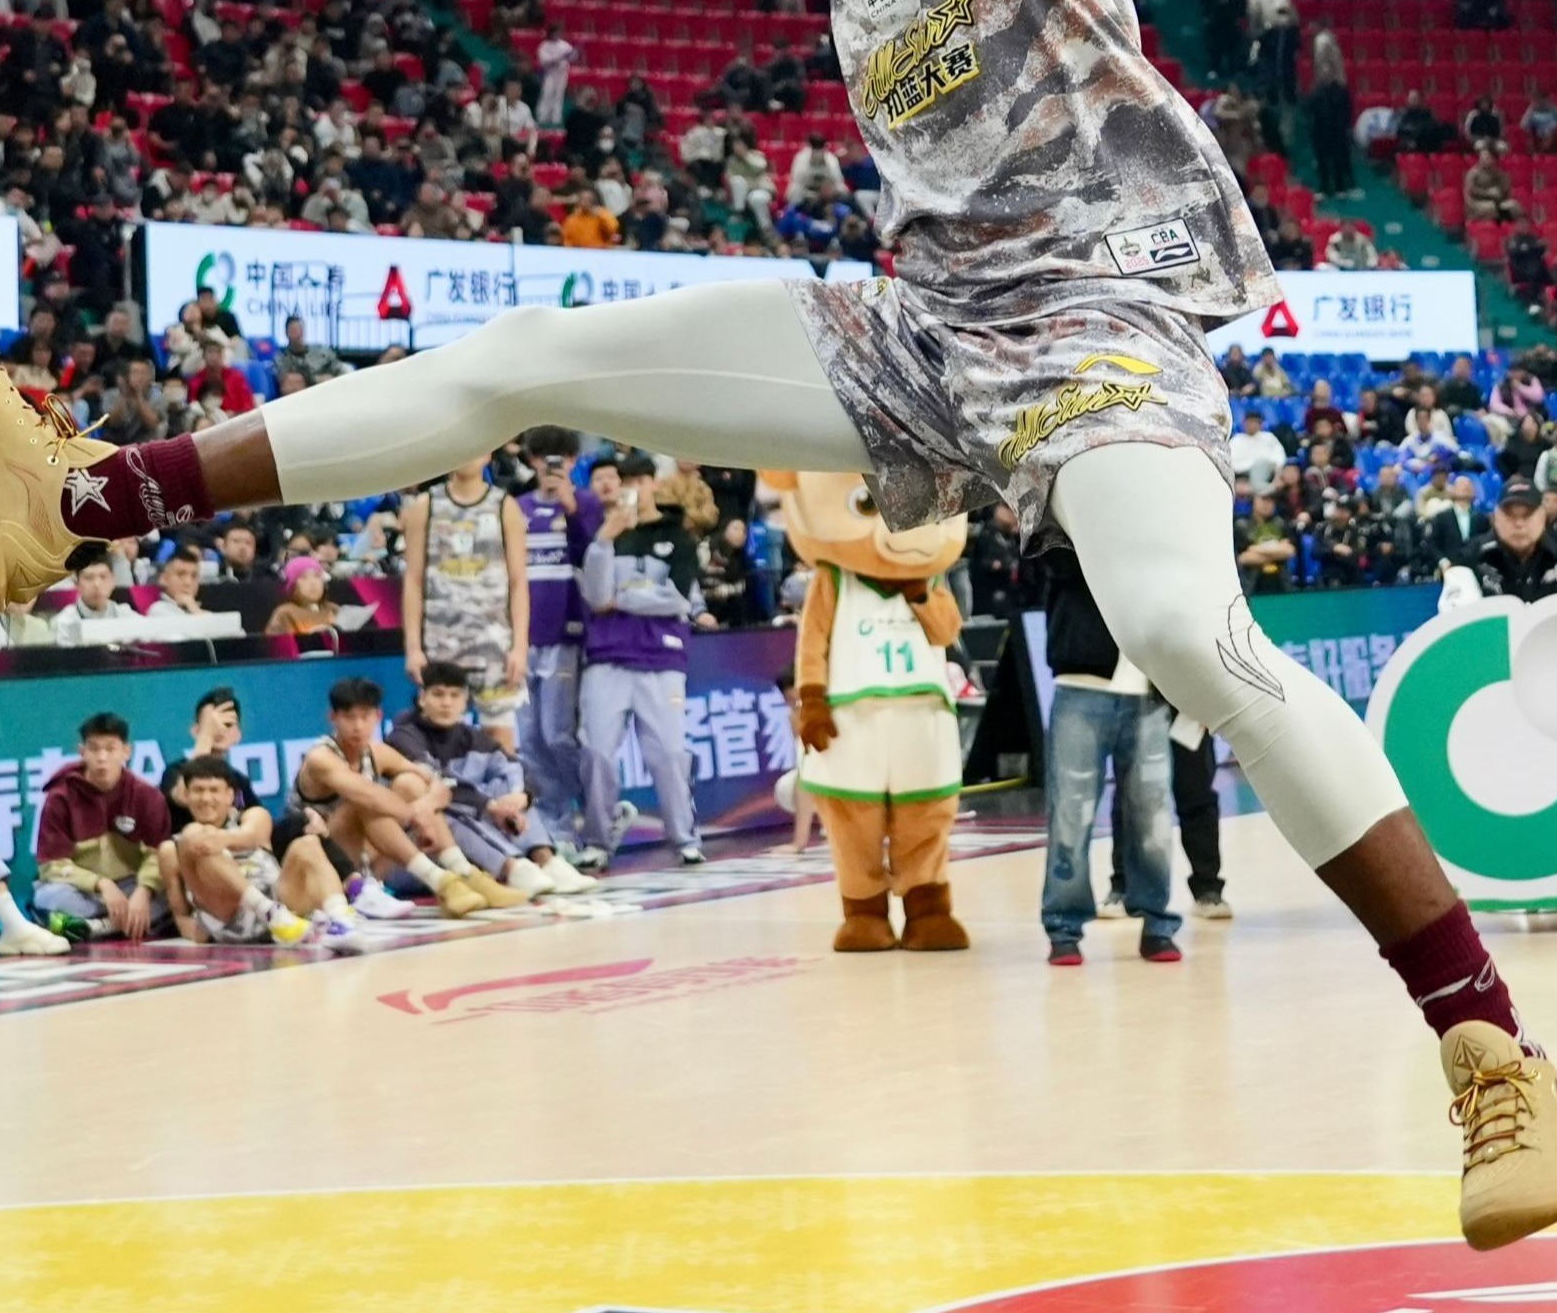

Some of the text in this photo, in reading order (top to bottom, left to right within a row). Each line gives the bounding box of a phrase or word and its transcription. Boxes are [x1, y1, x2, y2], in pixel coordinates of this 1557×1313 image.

[871, 0, 896, 19] CHINA
[886, 43, 975, 124] 扣篮大赛
[1150, 228, 1179, 244] CBA
[427, 270, 518, 307] 广发银行
[1312, 293, 1411, 322] 广发银行
[876, 641, 915, 673] 11
